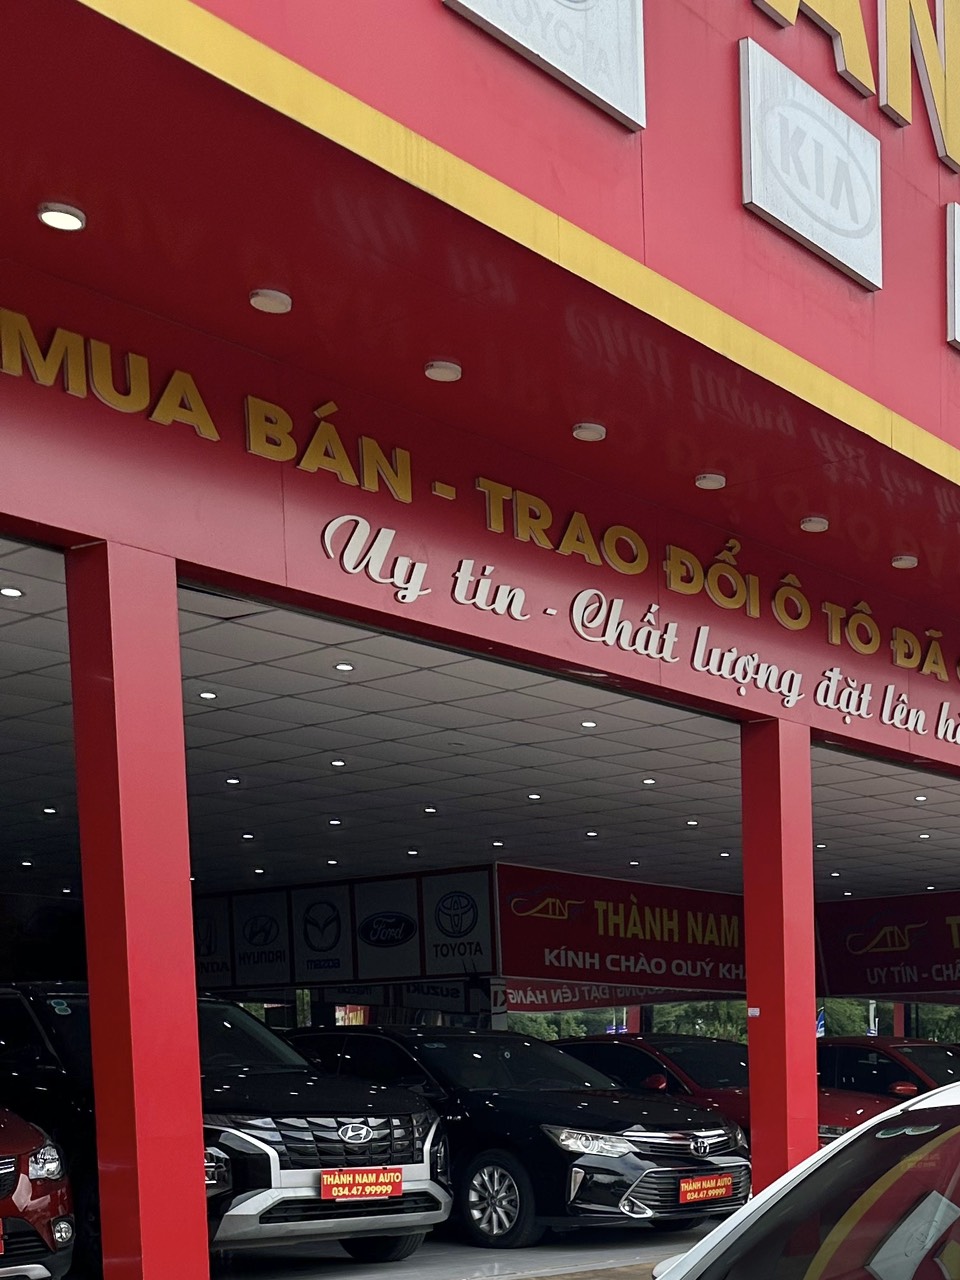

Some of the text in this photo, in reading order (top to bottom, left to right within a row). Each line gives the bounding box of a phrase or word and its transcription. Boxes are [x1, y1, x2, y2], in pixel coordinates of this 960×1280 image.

[495, 0, 612, 82] OYOTA
[778, 116, 859, 225] KIA
[0, 307, 220, 441] MUA
[245, 395, 412, 503] BÁN
[475, 476, 649, 575] TRAO
[664, 539, 760, 619] ĐỔI
[772, 575, 811, 631] Ô
[823, 601, 881, 656] TÔ
[891, 628, 948, 683] ĐÃ
[321, 514, 432, 604] Uy
[453, 559, 530, 620] tín
[570, 588, 680, 663] Chất
[692, 626, 803, 708] lượng
[816, 667, 874, 725] đặt
[880, 685, 929, 735] lên
[370, 917, 407, 941] Ford
[594, 893, 739, 948] THÀNH NAM
[433, 942, 483, 958] TOYOTA
[544, 945, 746, 980] KÍNH CHÀO QUÝ KH
[866, 967, 887, 984] UY
[890, 962, 919, 984] TÍN
[322, 1171, 402, 1185] THÀNH NAM AUTO
[332, 1185, 392, 1196] 034.47.99999
[681, 1177, 732, 1192] THÀNH NAM AUTO
